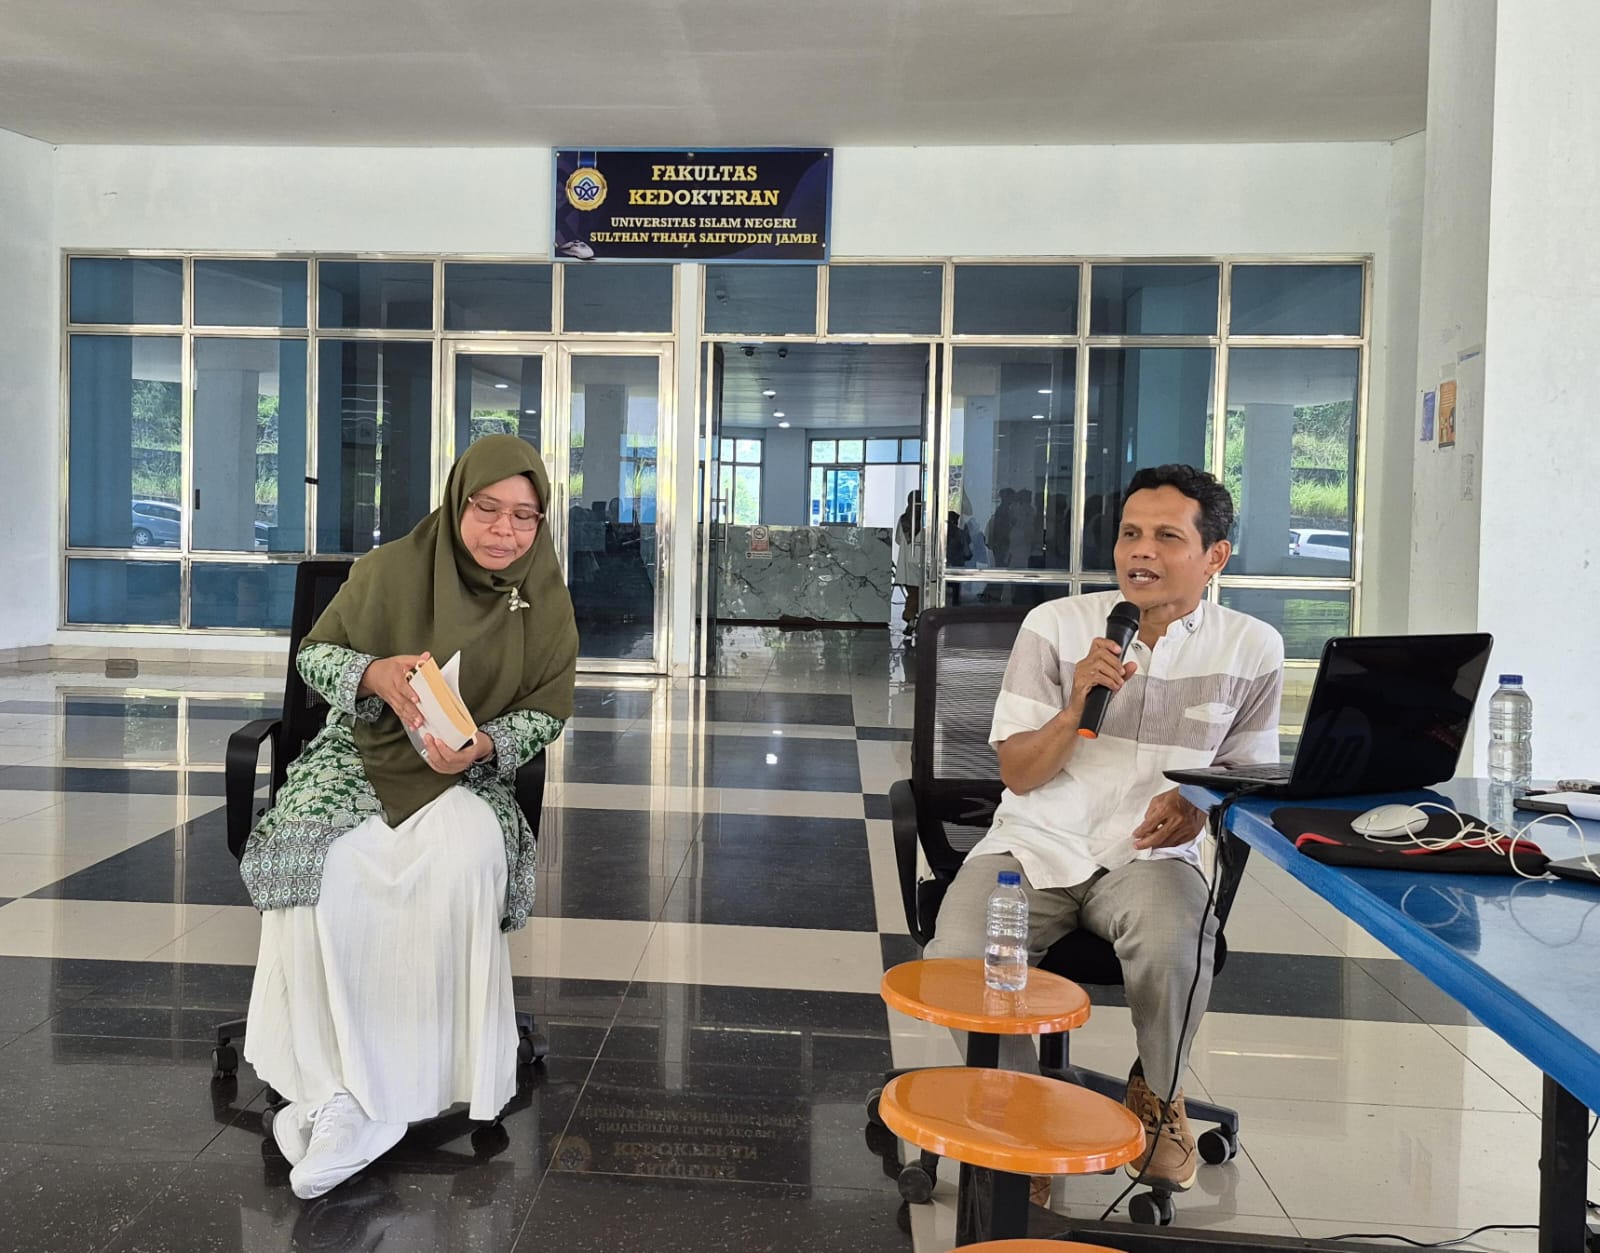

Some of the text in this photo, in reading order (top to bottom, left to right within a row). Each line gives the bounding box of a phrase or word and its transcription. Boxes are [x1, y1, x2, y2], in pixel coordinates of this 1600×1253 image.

[652, 165, 757, 181] FAKULTAS
[629, 189, 780, 206] KEDOKTERAN
[611, 217, 797, 229] UNIVERSITAS ISLAM NEGERI
[590, 232, 818, 245] SULTHAN THAHA SAIFUDDIN JAMBI
